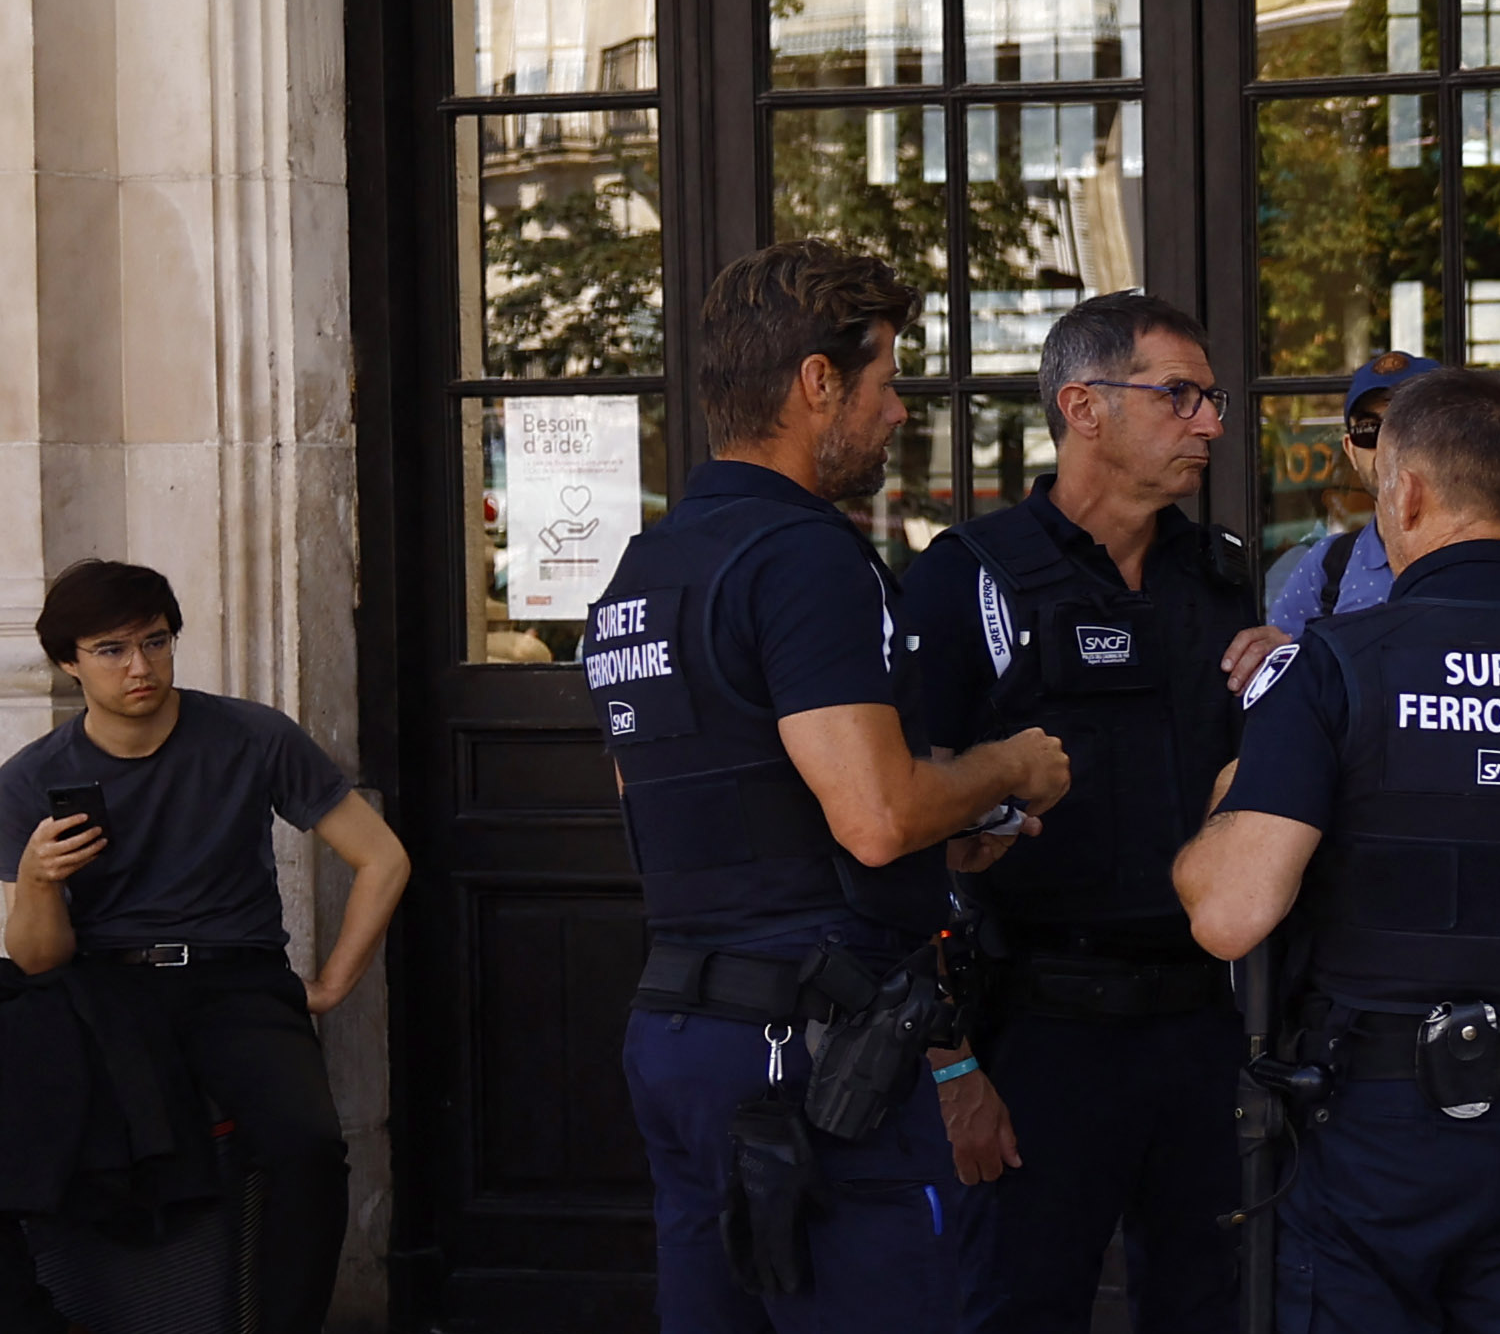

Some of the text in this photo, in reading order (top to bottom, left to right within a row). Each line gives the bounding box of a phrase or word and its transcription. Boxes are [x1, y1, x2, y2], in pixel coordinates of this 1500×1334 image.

[523, 412, 587, 433] Besoin
[595, 598, 647, 642] SURETE
[985, 613, 1006, 656] SURETE
[1084, 635, 1127, 650] SNCF
[585, 640, 673, 691] FERROVIAIRE
[612, 712, 633, 730] SNCF
